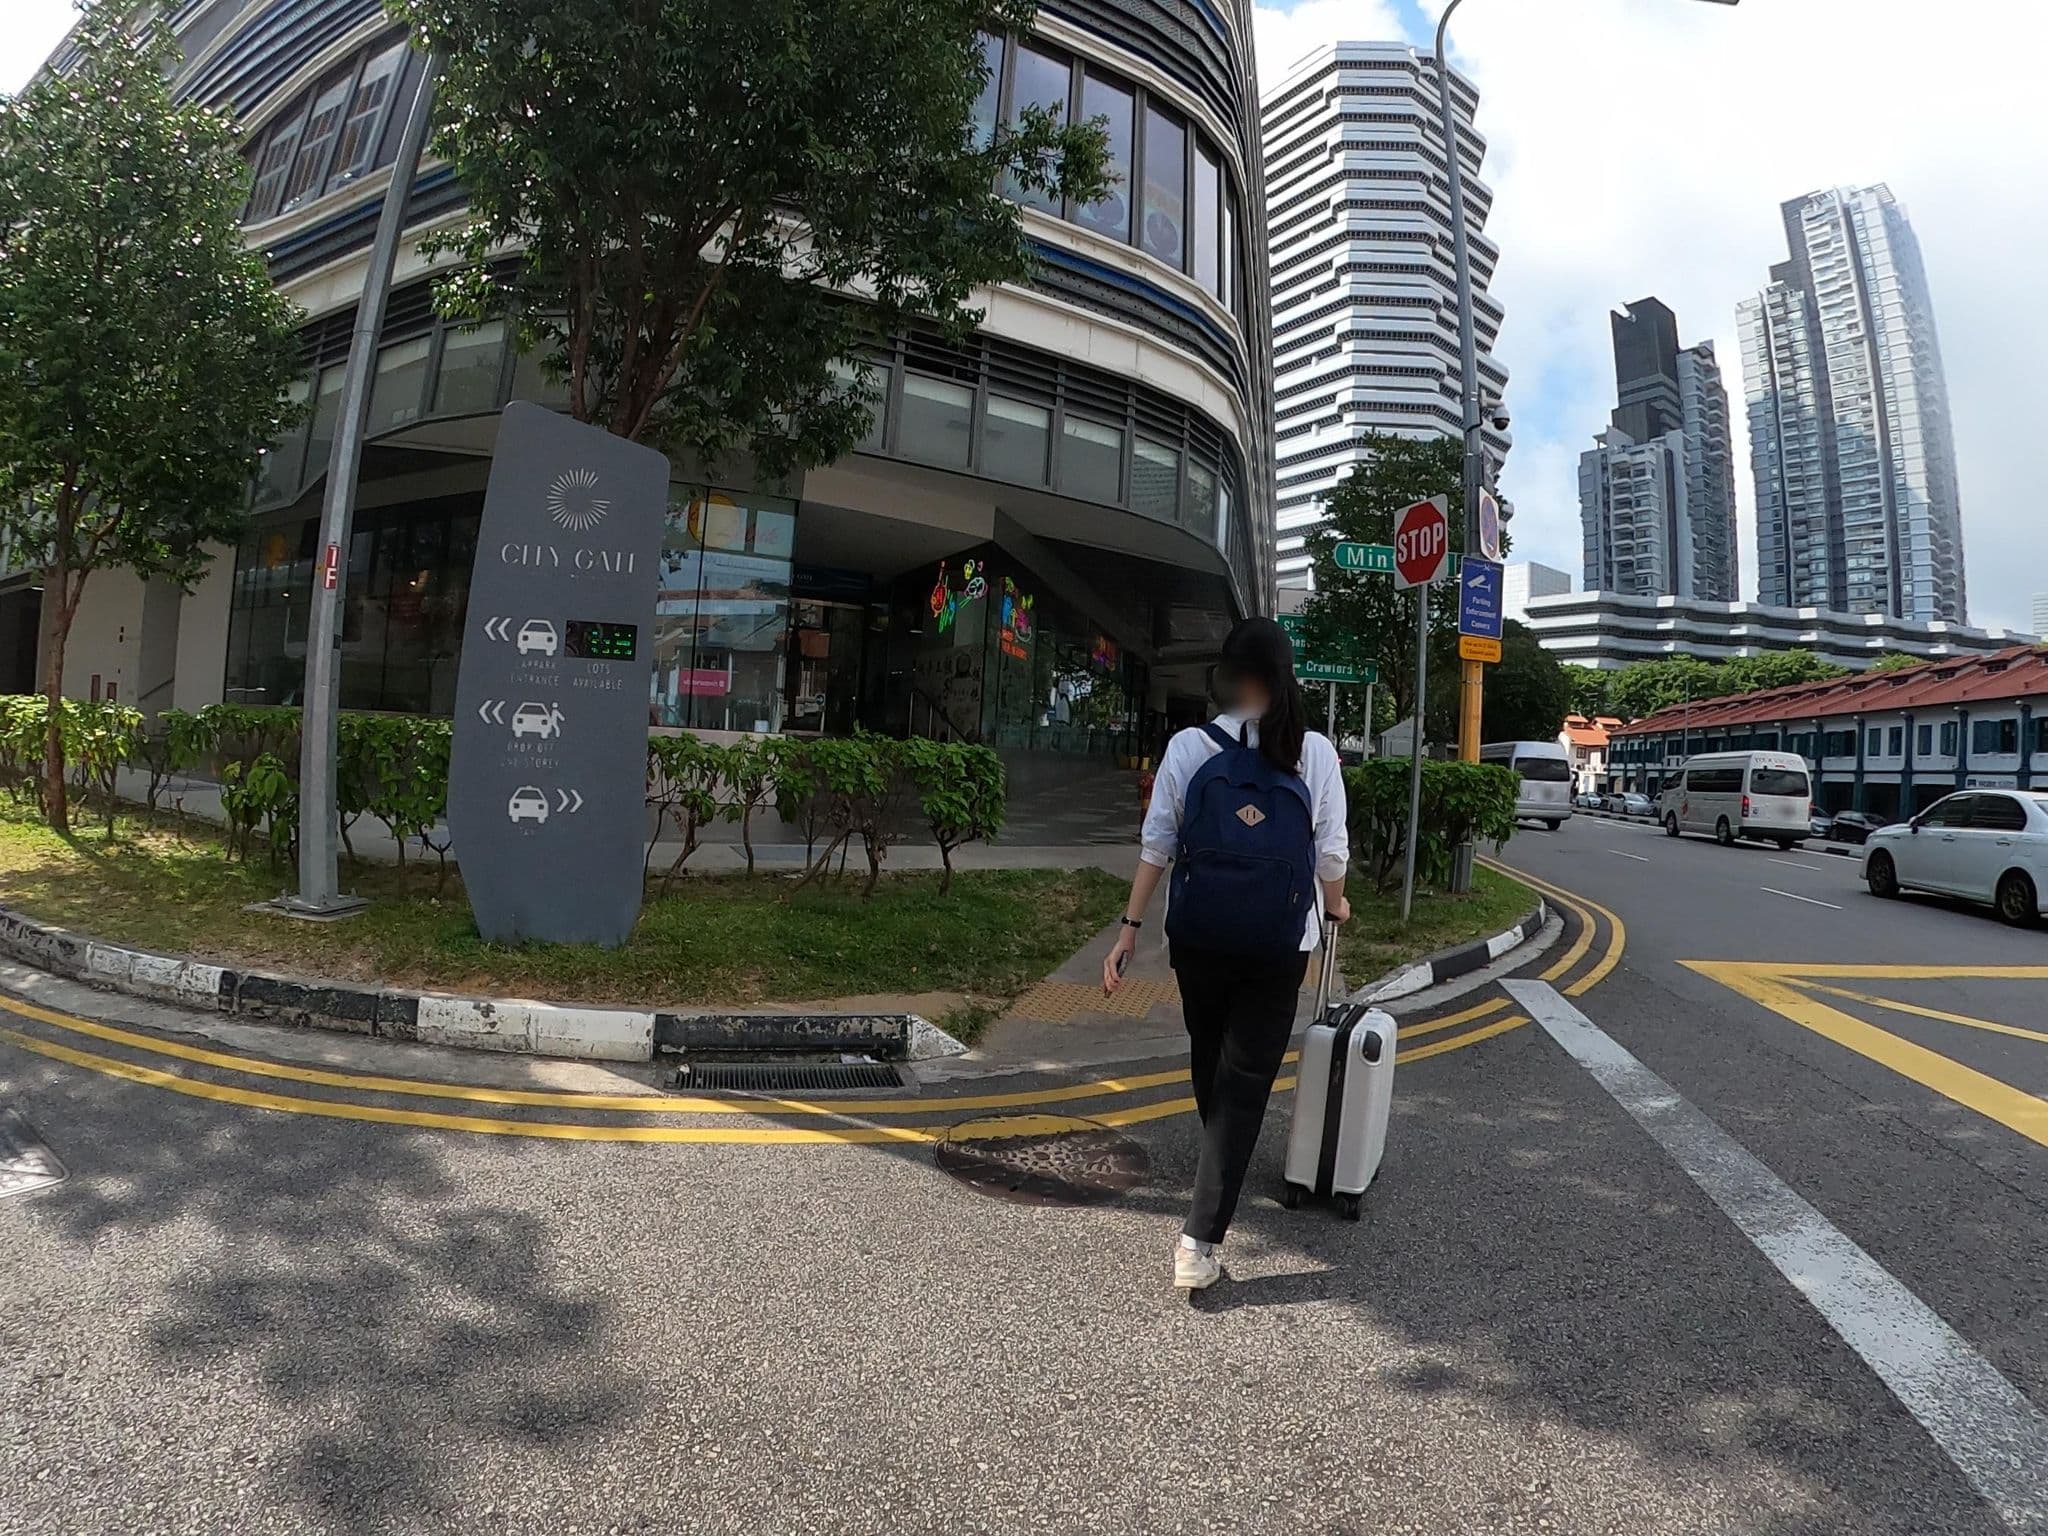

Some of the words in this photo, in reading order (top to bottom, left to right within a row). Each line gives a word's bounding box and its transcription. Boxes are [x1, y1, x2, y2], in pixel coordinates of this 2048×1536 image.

[1397, 521, 1444, 564] STOP
[1347, 547, 1391, 568] Min
[586, 663, 611, 674] LOTS
[1305, 660, 1353, 675] Crawford
[573, 677, 624, 690] AVAILABLE
